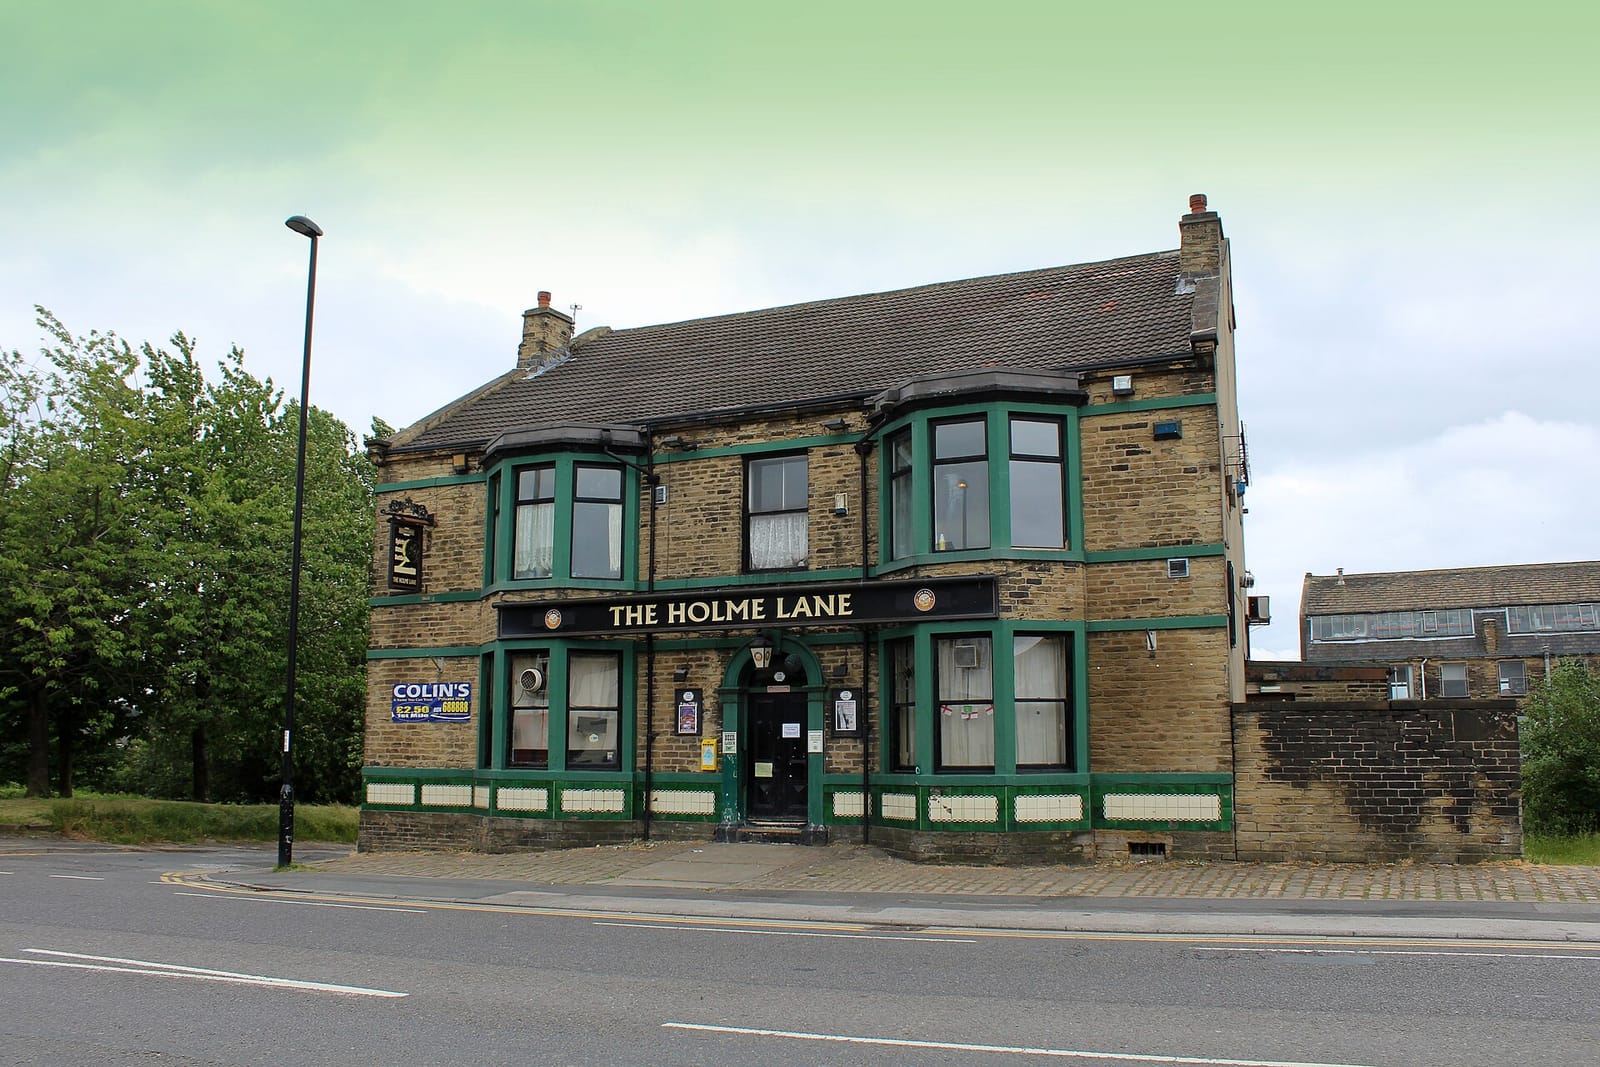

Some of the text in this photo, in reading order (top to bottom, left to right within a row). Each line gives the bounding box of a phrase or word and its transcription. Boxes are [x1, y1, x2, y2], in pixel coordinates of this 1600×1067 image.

[609, 593, 854, 626] THE HOLME LANE
[393, 683, 470, 698] COLIN'S
[396, 705, 430, 714] £2.50
